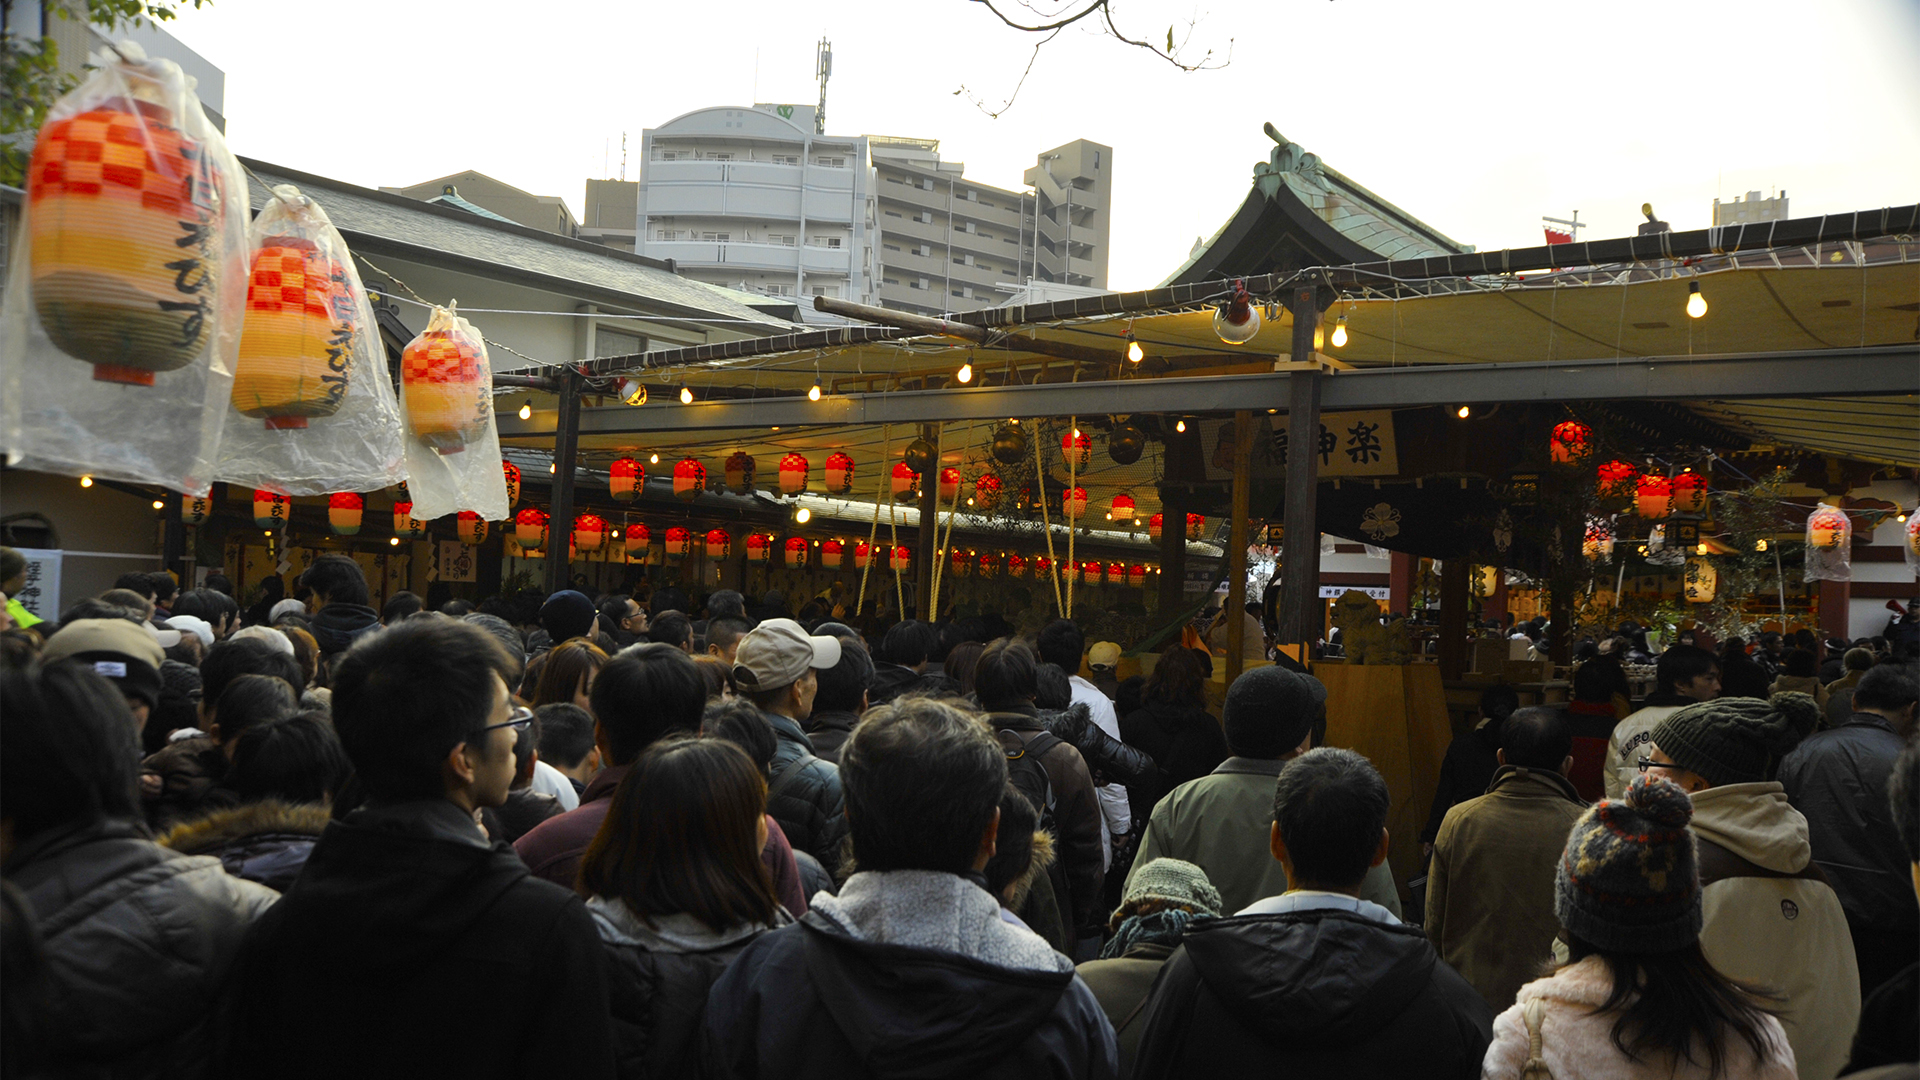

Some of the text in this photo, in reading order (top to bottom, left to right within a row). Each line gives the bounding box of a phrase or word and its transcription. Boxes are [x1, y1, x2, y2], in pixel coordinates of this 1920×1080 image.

[20, 561, 42, 616] 蛭子神社
[1619, 729, 1650, 761] LUPO
